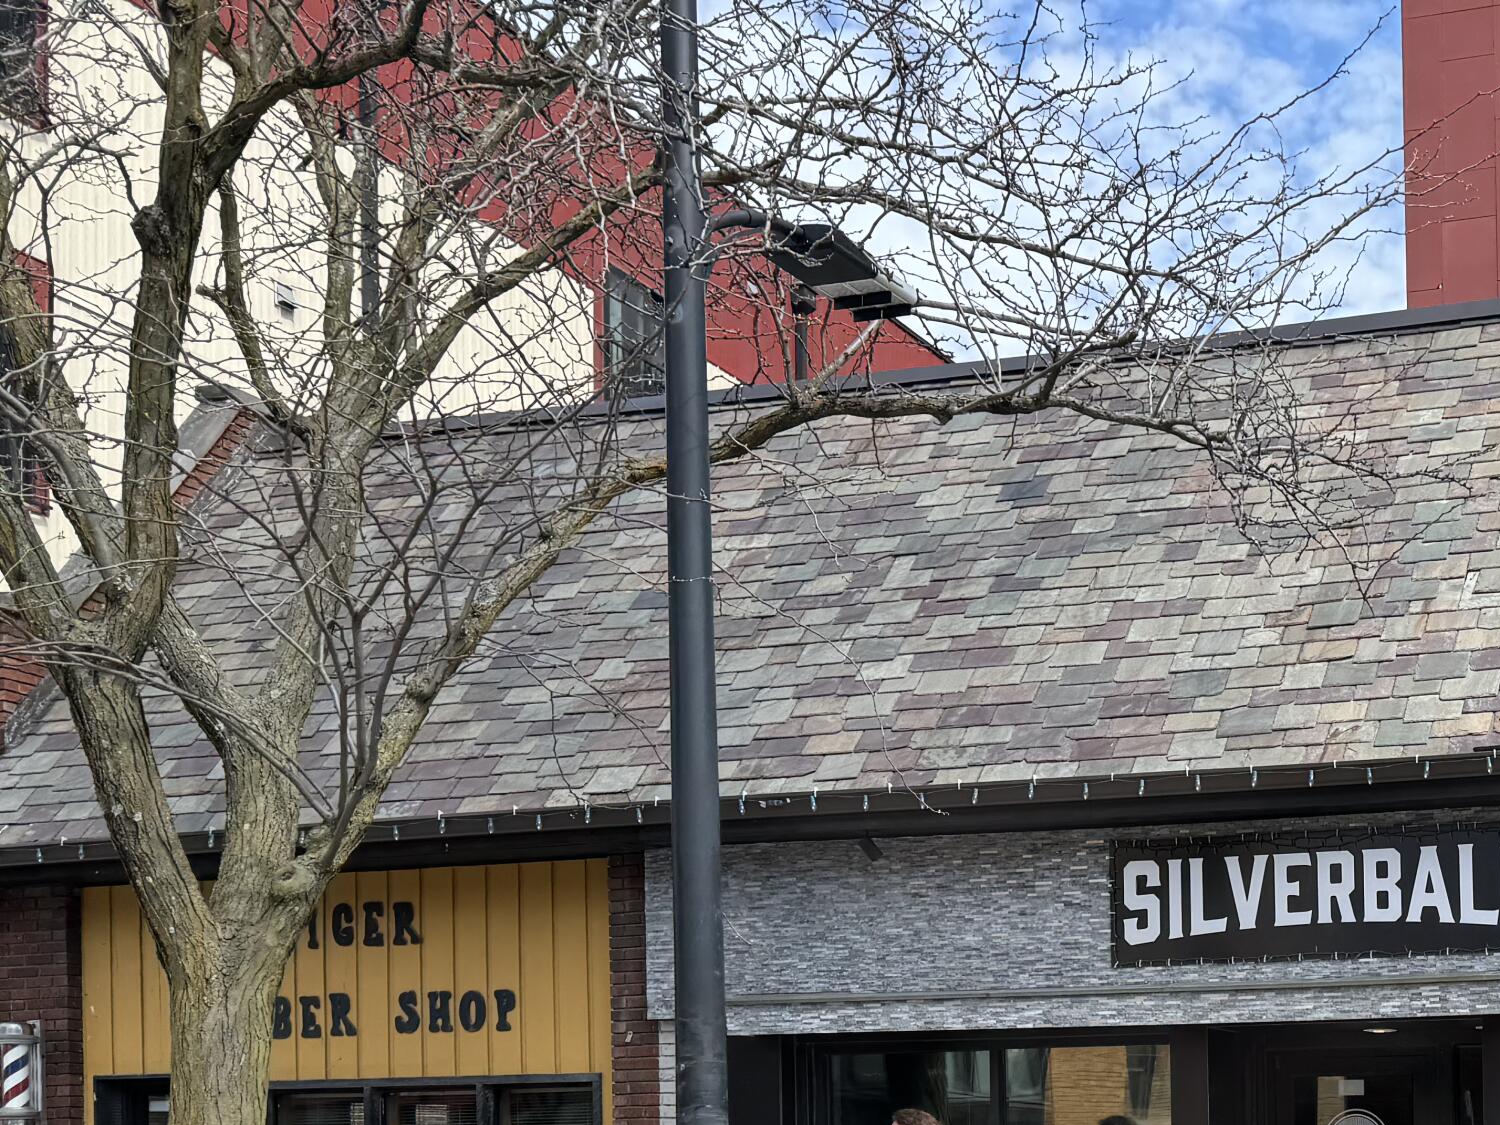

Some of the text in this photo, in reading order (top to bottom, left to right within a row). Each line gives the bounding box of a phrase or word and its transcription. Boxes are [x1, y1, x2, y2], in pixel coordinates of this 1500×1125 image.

[306, 900, 424, 949] IGER
[272, 988, 517, 1040] BER SHOP
